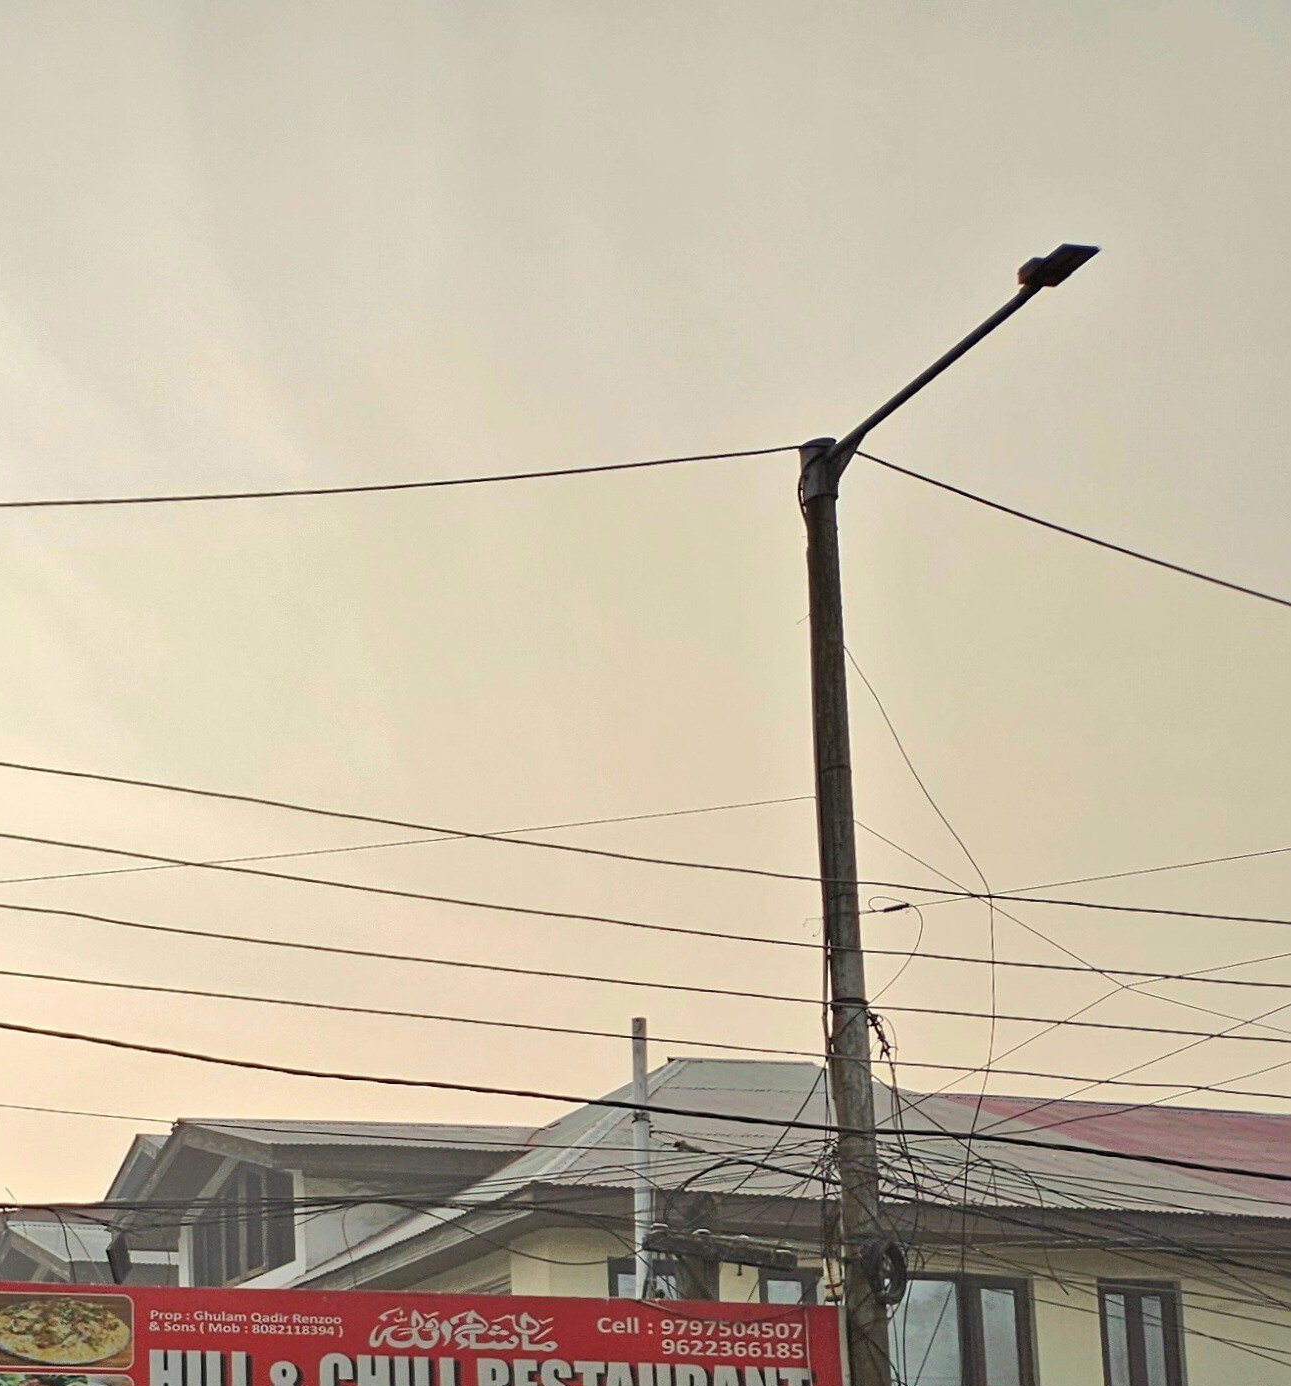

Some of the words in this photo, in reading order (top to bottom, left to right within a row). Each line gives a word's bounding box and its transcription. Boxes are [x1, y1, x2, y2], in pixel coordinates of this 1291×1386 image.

[149, 1309, 182, 1322] Prop
[193, 1310, 247, 1322] Ghulam
[250, 1312, 288, 1324] Qadir
[292, 1313, 342, 1325] Renzoo
[149, 1321, 160, 1332] &
[164, 1322, 196, 1332] Sons
[208, 1323, 241, 1333] Mob
[252, 1324, 335, 1336] 8082118394
[597, 1316, 639, 1335] Cell
[661, 1319, 804, 1340] 9797504507
[661, 1339, 805, 1360] 9622366185
